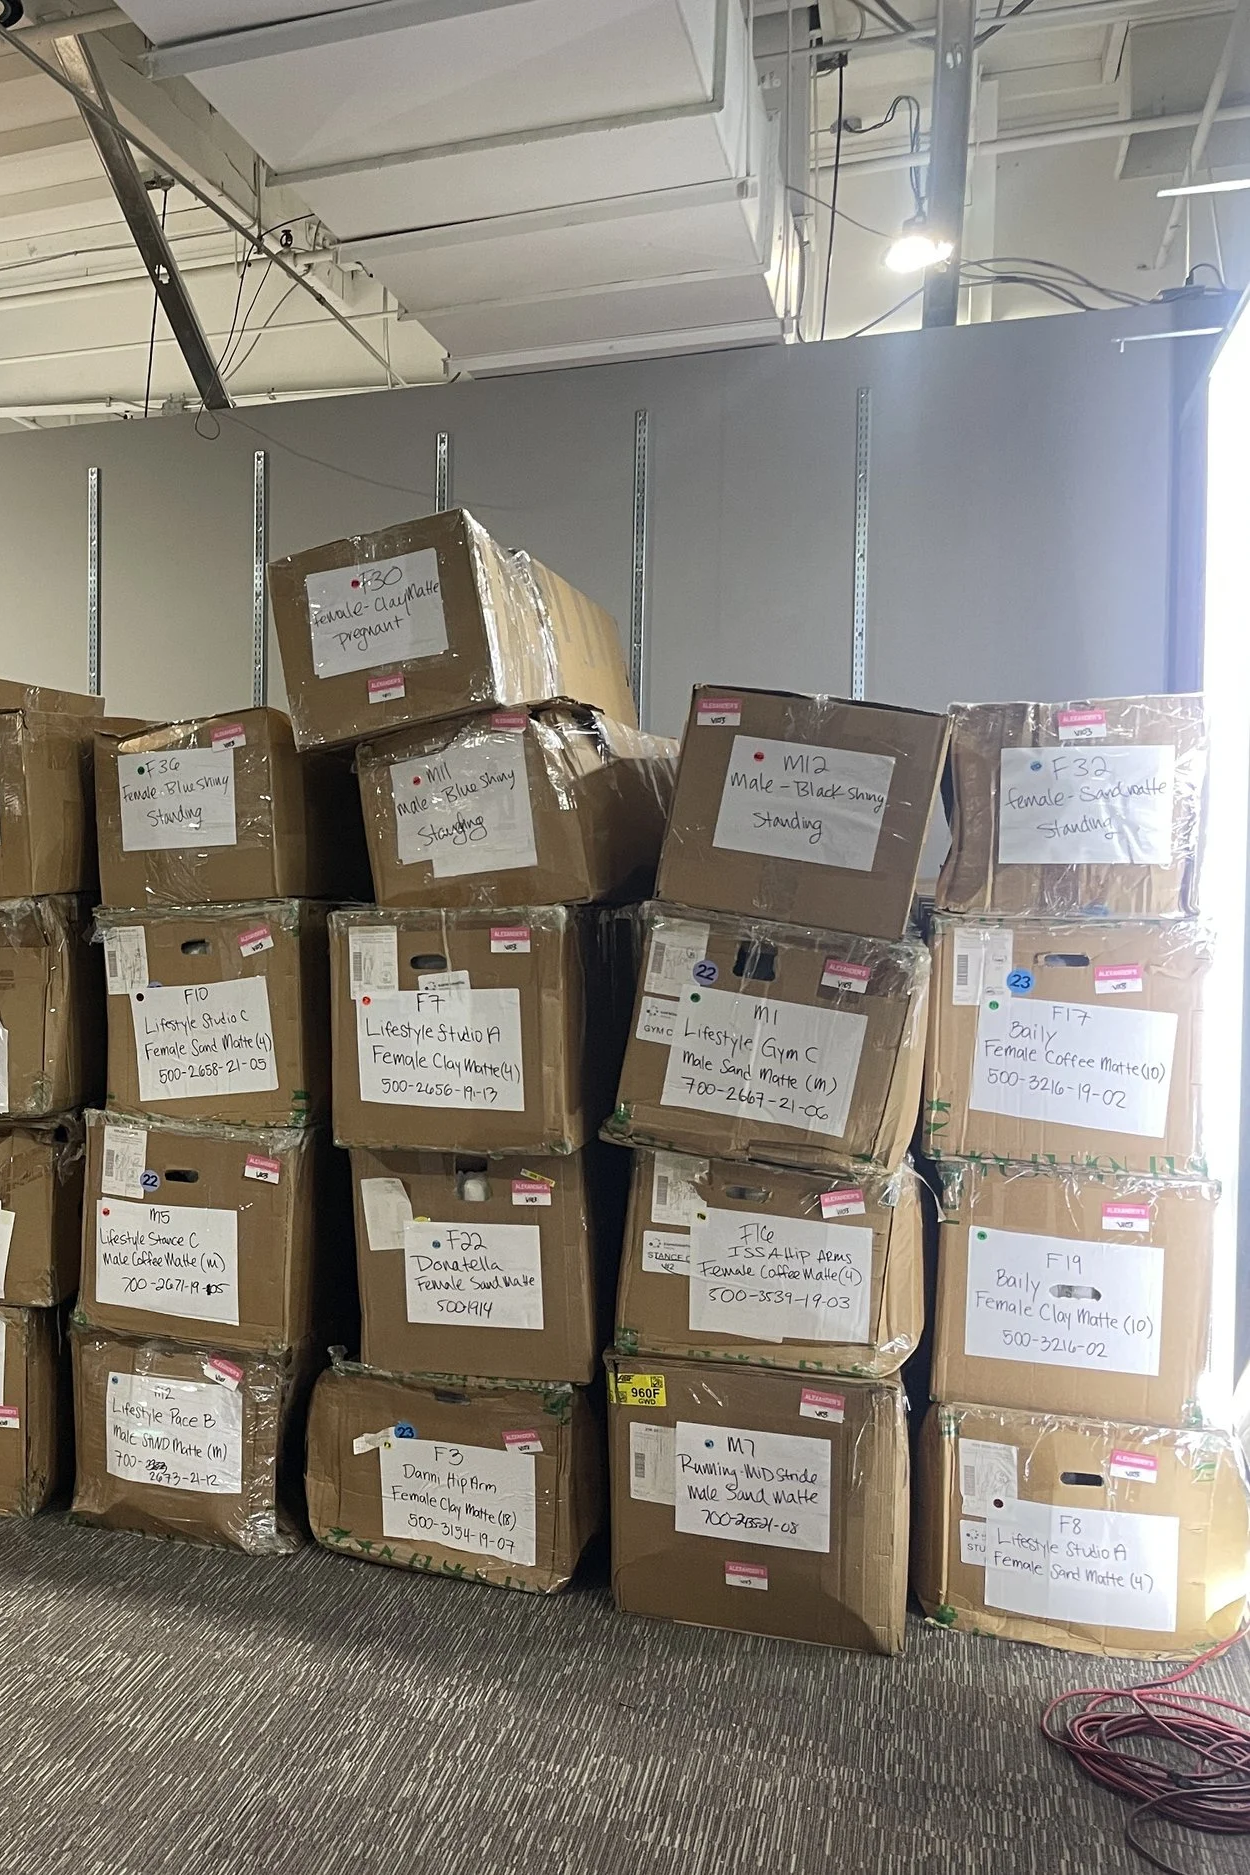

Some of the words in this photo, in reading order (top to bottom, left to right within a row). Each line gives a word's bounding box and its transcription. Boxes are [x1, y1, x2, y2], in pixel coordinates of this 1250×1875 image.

[359, 566, 402, 594] F30
[1062, 714, 1103, 723] ALEXANDER'S
[783, 755, 829, 774] M12
[165, 781, 196, 794] Blue
[441, 782, 477, 804] Blue
[794, 781, 847, 799] Black
[753, 811, 822, 844] Standing
[695, 965, 717, 980] 22
[828, 963, 867, 977] ALEXANDER'S
[1010, 975, 1031, 989] 23
[184, 987, 209, 1004] F10
[417, 993, 446, 1013] F7
[203, 1013, 236, 1029] Studio
[240, 1010, 248, 1022] C
[1053, 1006, 1092, 1025] F17
[438, 1022, 482, 1043] Studio
[487, 1027, 500, 1043] A
[1009, 1021, 1058, 1049] Baily
[144, 1043, 185, 1060] Female
[192, 1039, 218, 1056] Sand
[761, 1037, 799, 1062] Gym
[805, 1046, 819, 1063] C
[984, 1039, 1037, 1062] Female
[1045, 1050, 1095, 1068] Coffee
[159, 1058, 267, 1084] 500-2658-21-05
[373, 1044, 428, 1069] Female
[433, 1053, 461, 1078] Clay
[720, 1059, 752, 1081] Sand
[987, 1068, 1126, 1109] 500-3216-19-02
[142, 1175, 157, 1187] 22
[100, 1230, 145, 1250] Lifestyle
[149, 1232, 184, 1246] Stance
[189, 1232, 199, 1248] C
[446, 1230, 487, 1250] F22
[132, 1252, 164, 1267] Coffee
[410, 1255, 504, 1272] Donatella
[1047, 1253, 1082, 1274] F19
[697, 1260, 755, 1279] Female
[761, 1265, 799, 1280] Coffee
[414, 1277, 469, 1292] Female
[470, 1277, 502, 1290] Sand
[996, 1269, 1040, 1302] Baily
[975, 1291, 1033, 1317] Female
[1039, 1304, 1071, 1330] Clay
[1003, 1330, 1108, 1358] 500-3216-02
[631, 1387, 660, 1398] 960F
[170, 1408, 198, 1428] Pace
[204, 1414, 216, 1428] B
[397, 1427, 414, 1438] 23
[434, 1447, 464, 1465] F3
[448, 1474, 467, 1493] Hip
[471, 1477, 497, 1493] Arm
[392, 1485, 437, 1507] Female
[440, 1496, 462, 1520] Clay
[726, 1484, 765, 1505] Sand
[1060, 1515, 1082, 1535] F8
[1066, 1543, 1109, 1560] Studio
[993, 1551, 1044, 1576] Female
[1050, 1562, 1080, 1580] Sand
